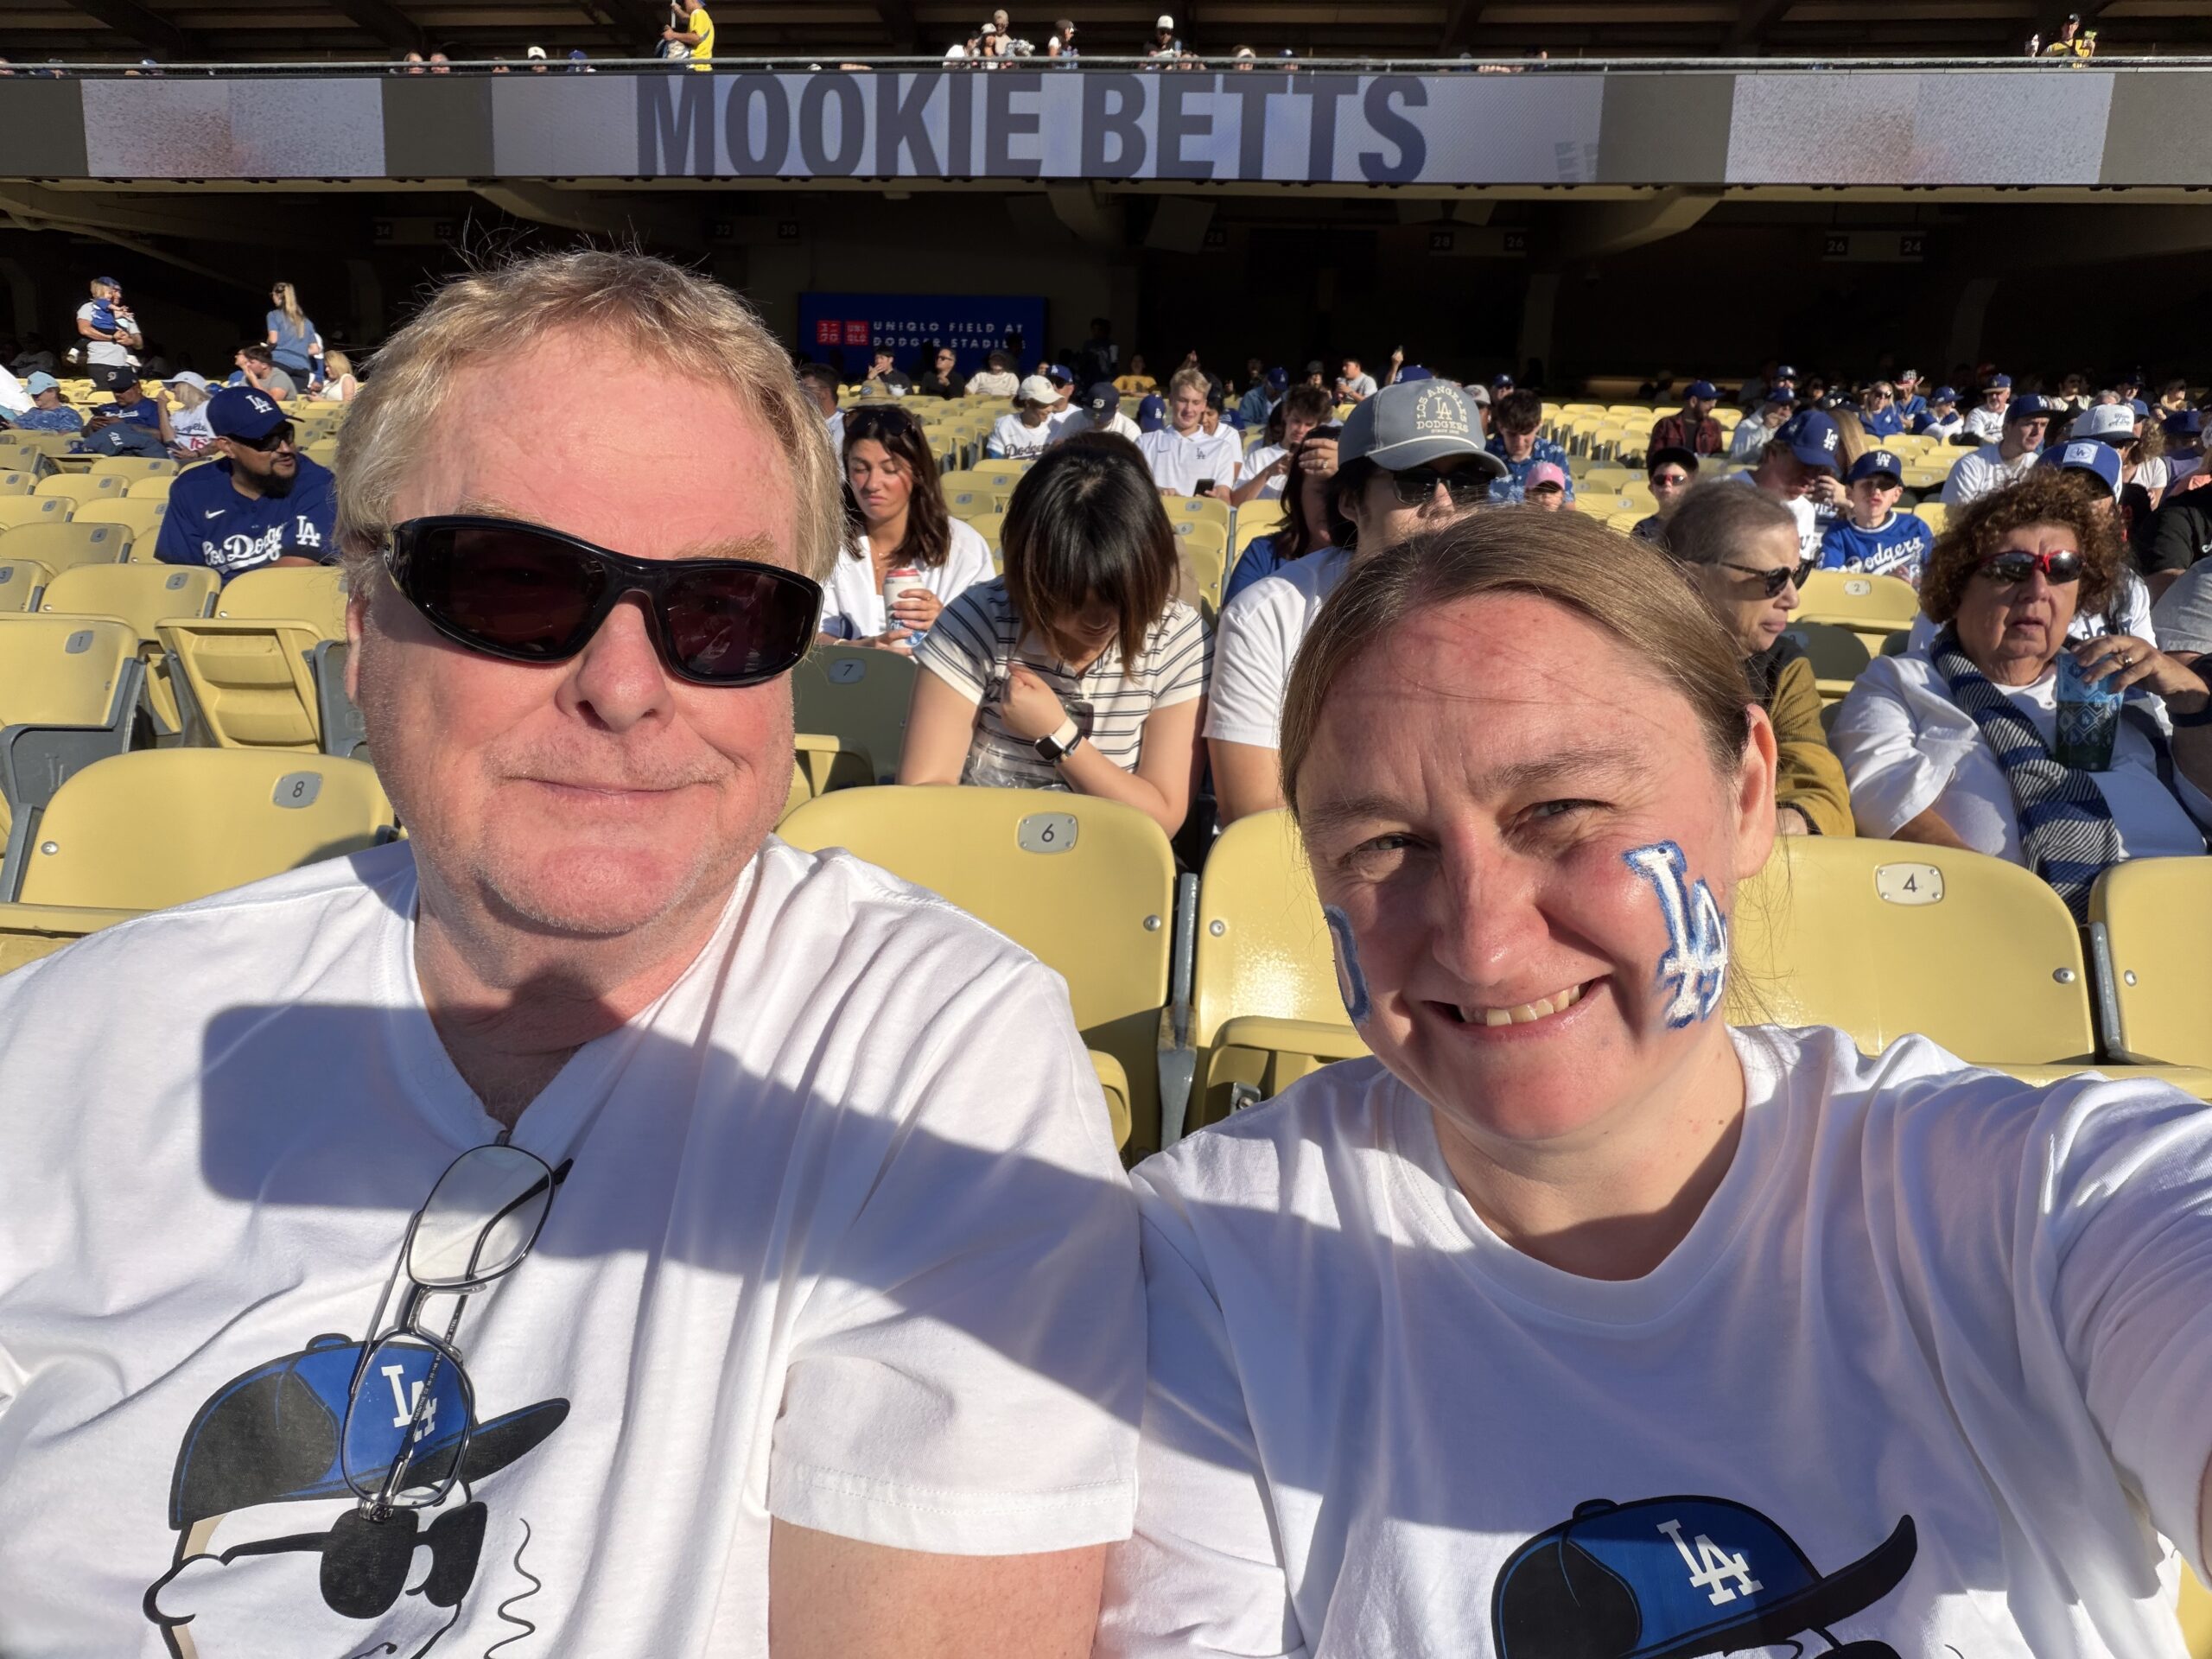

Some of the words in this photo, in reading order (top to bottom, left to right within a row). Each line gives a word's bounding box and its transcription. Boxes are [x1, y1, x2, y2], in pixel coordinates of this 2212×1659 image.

[637, 73, 1042, 176] MOOKIE
[1081, 74, 1429, 183] BETTS
[780, 225, 797, 236] 30
[1433, 236, 1451, 247] 28
[1507, 236, 1524, 248] 26
[1827, 240, 1846, 252] 26
[1904, 240, 1922, 252] 24
[873, 321, 940, 333] UNIQLO
[949, 323, 995, 334] FIELD
[1005, 324, 1024, 334] AT
[873, 337, 941, 347] DODGR
[245, 395, 273, 413] LA
[1417, 397, 1428, 419] LOS
[1427, 385, 1467, 423] ANGELES
[1434, 397, 1452, 420] LA
[1416, 420, 1469, 433] DODGERS
[1876, 451, 1891, 467] LA
[296, 515, 321, 548] LA
[842, 664, 854, 677] 7
[292, 780, 305, 798] 8
[1041, 823, 1055, 842] 6
[1903, 872, 1918, 893] 4
[1621, 839, 1728, 1029] LA
[1657, 1518, 1764, 1606] LA
